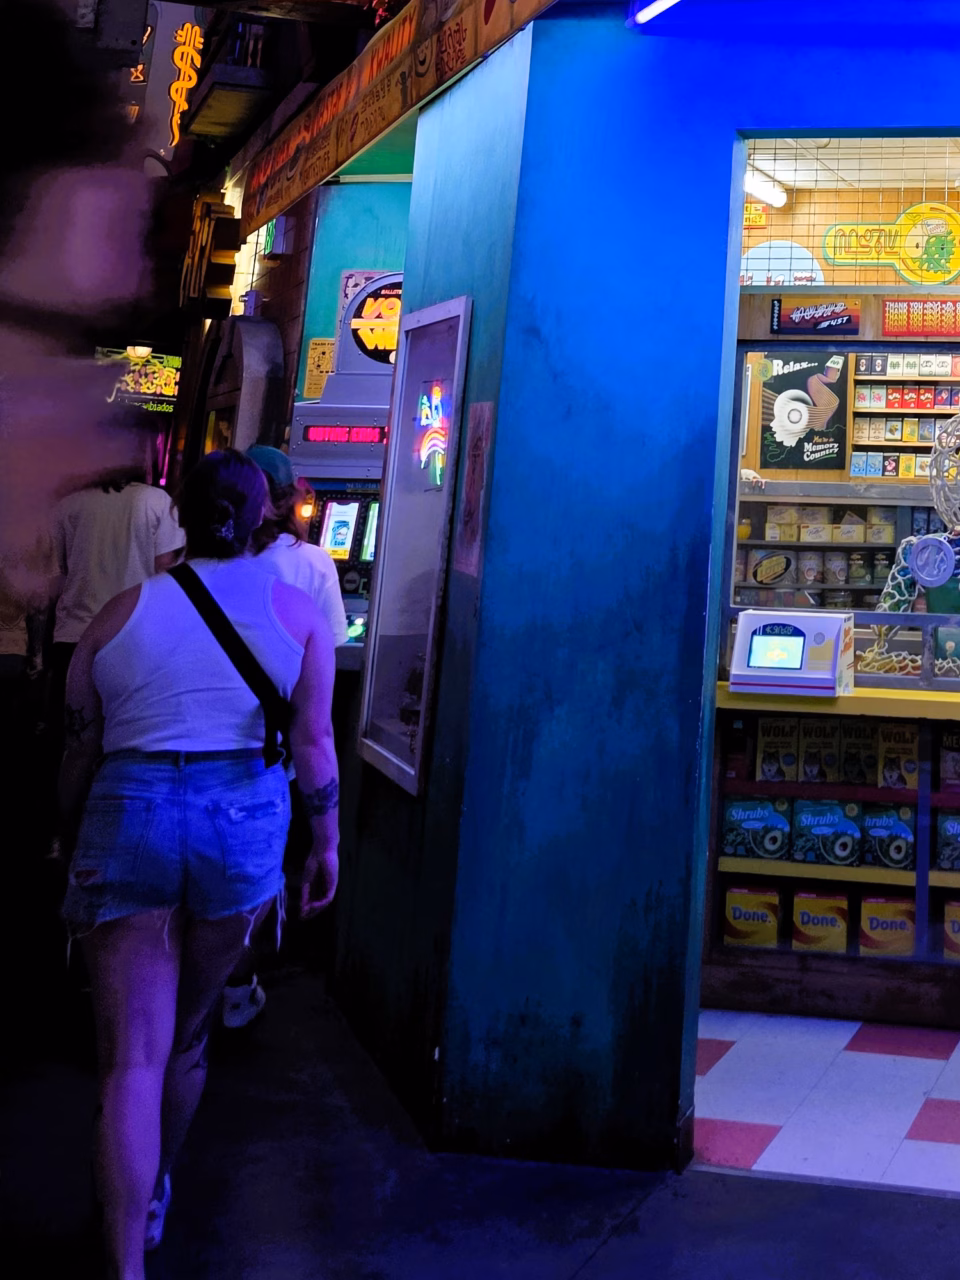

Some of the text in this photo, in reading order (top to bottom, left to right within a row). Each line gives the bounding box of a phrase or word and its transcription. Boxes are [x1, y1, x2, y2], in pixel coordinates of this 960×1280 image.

[772, 358, 818, 376] Relax...
[803, 442, 839, 452] Memory
[803, 446, 839, 462] Country
[762, 724, 797, 738] WOLF
[803, 726, 838, 739] WOLF
[843, 726, 878, 740] WOLF
[882, 731, 917, 744] WOLF
[731, 807, 769, 821] Shrubs
[801, 812, 839, 826] Shrubs
[865, 815, 893, 827] hrubs
